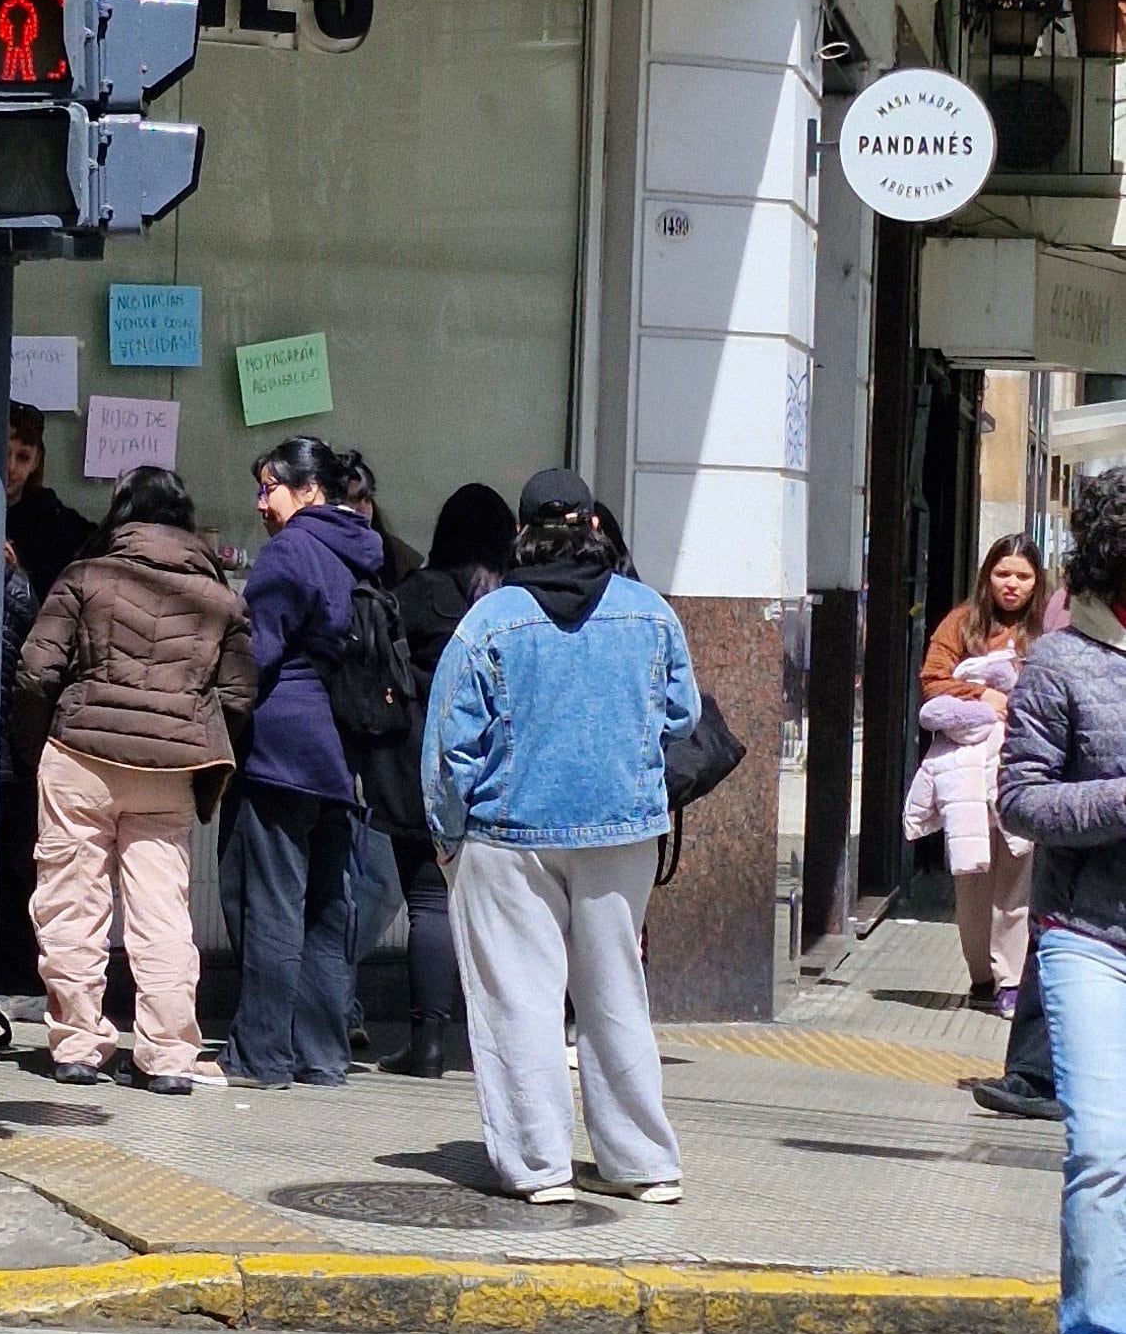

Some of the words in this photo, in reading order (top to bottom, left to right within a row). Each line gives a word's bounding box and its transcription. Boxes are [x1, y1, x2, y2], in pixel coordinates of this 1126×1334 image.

[876, 92, 911, 118] MASA
[918, 91, 962, 118] MADRE
[858, 131, 973, 156] PANDANÉS
[879, 177, 955, 199] ARGENTINA
[145, 411, 168, 428] DE
